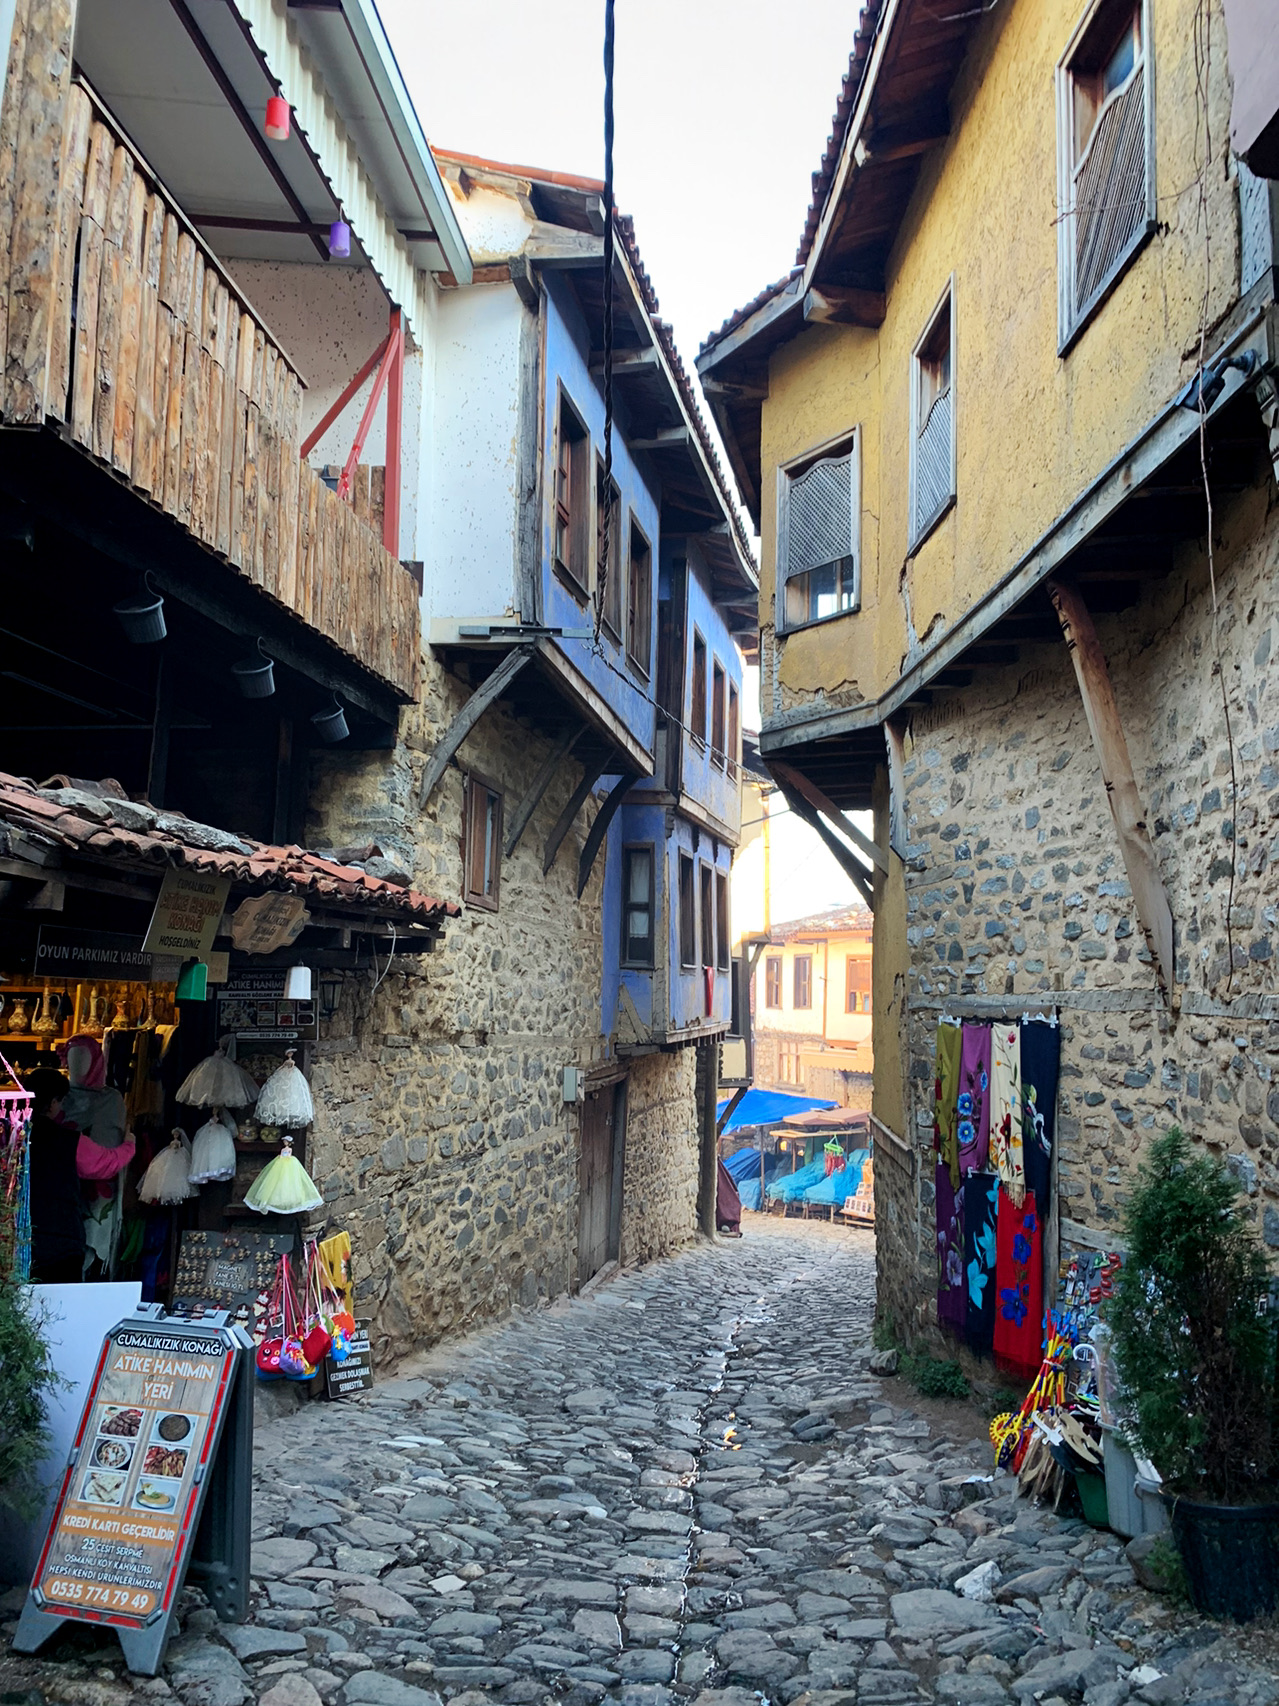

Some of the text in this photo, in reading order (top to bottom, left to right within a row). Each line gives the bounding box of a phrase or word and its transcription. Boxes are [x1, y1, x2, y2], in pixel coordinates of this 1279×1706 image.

[167, 912, 205, 932] KONAĞI
[159, 935, 201, 949] HOŞGELDİNİZ
[38, 944, 69, 959] OYUN
[72, 947, 119, 963] PARKIMIZ
[120, 951, 152, 966] VARDIR
[228, 979, 284, 990] ATİKE HANIMI
[117, 1334, 222, 1356] CUMALIKIZIK KONAĞI
[113, 1353, 215, 1380] ATİKE HANIMIN
[144, 1381, 174, 1400] YERİ
[62, 1515, 175, 1541] KREDİ KARTI GEÇERLİDİR
[81, 1537, 96, 1551] 25
[116, 1546, 144, 1559] SERPME
[64, 1553, 96, 1567] OSMANLI
[113, 1561, 153, 1575] KAHVALTISI
[51, 1580, 149, 1610] 0535 774 79 49
